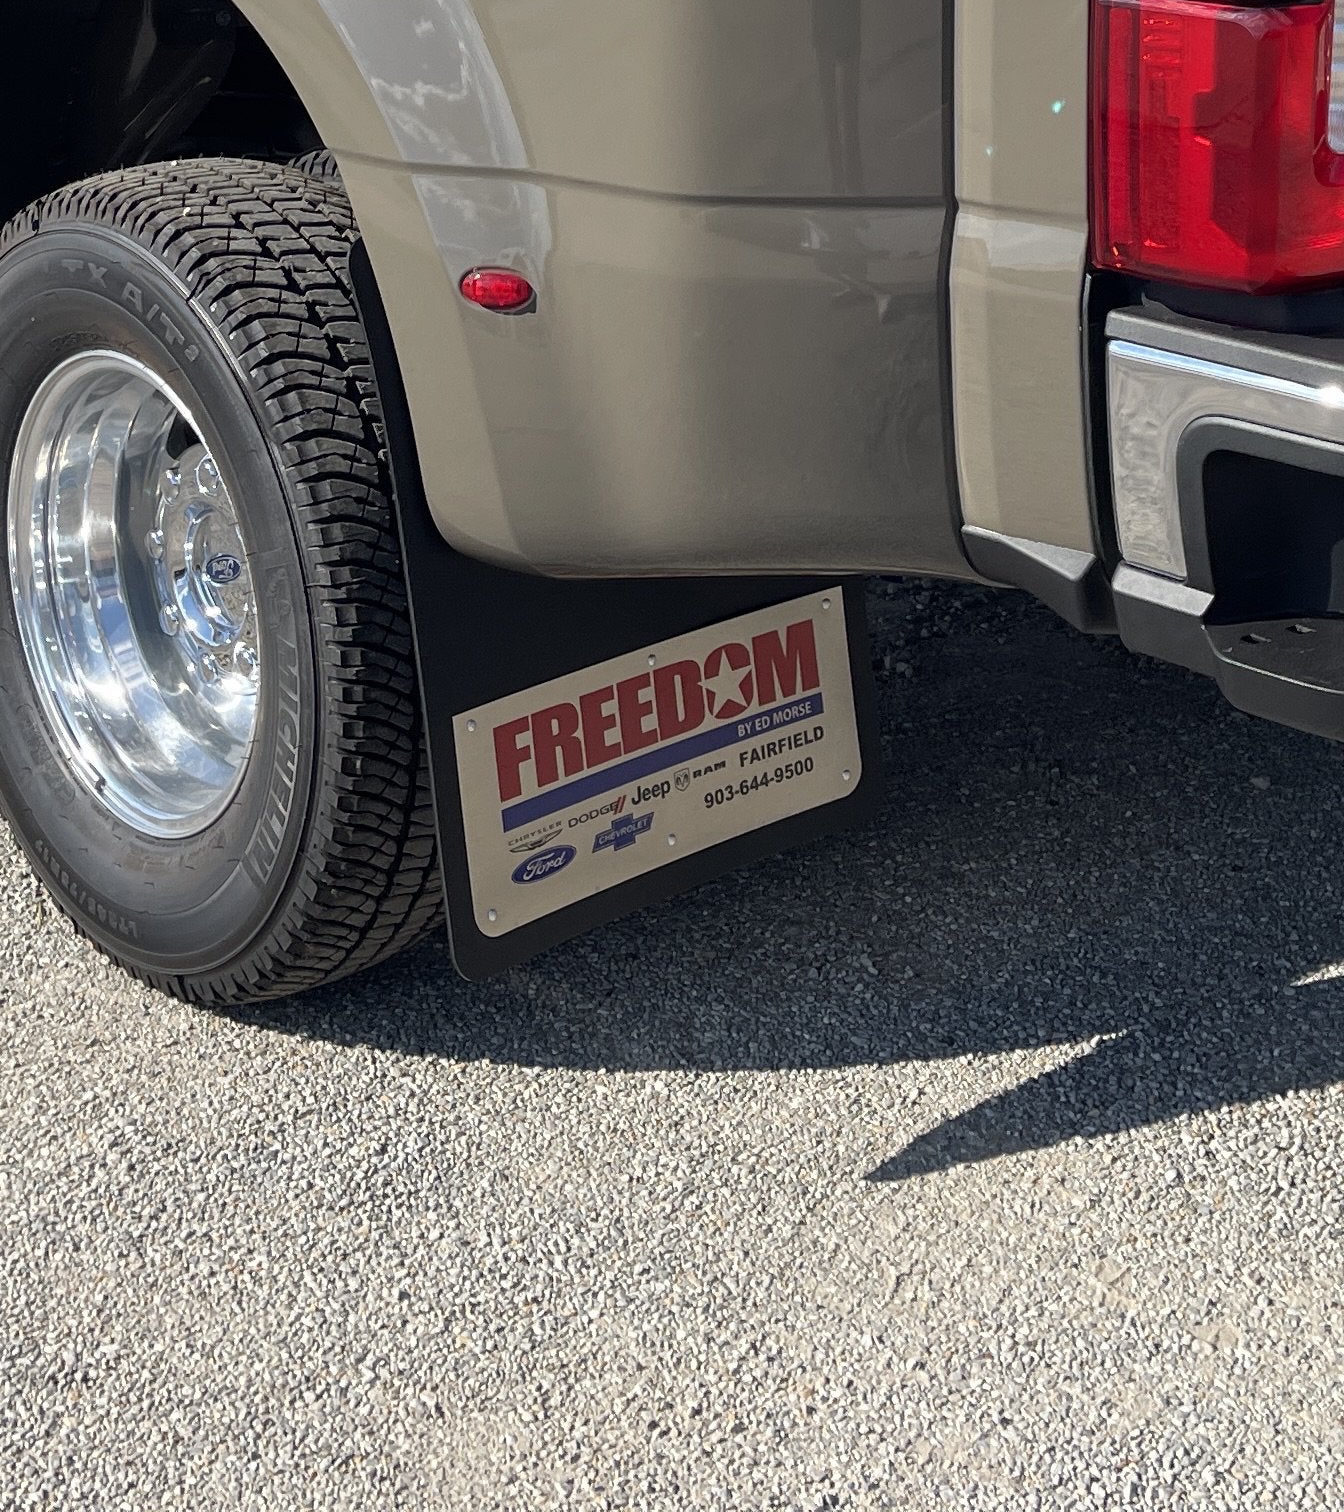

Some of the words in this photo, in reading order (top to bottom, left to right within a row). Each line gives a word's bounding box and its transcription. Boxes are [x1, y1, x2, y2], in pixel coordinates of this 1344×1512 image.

[492, 618, 820, 804] FREEDOM
[737, 721, 753, 738] BY
[755, 716, 771, 731] ED
[772, 701, 813, 726] MORSE
[245, 635, 301, 884] MICHELIN
[739, 725, 825, 768] FAIRFIELD
[693, 760, 727, 779] RAM
[703, 756, 814, 809] 903-644-9500
[631, 779, 671, 806] Jeep
[567, 800, 620, 829] DODGE
[507, 820, 563, 847] CHRYSLER
[598, 818, 648, 845] CHEVROLET
[522, 851, 566, 881] Ford
